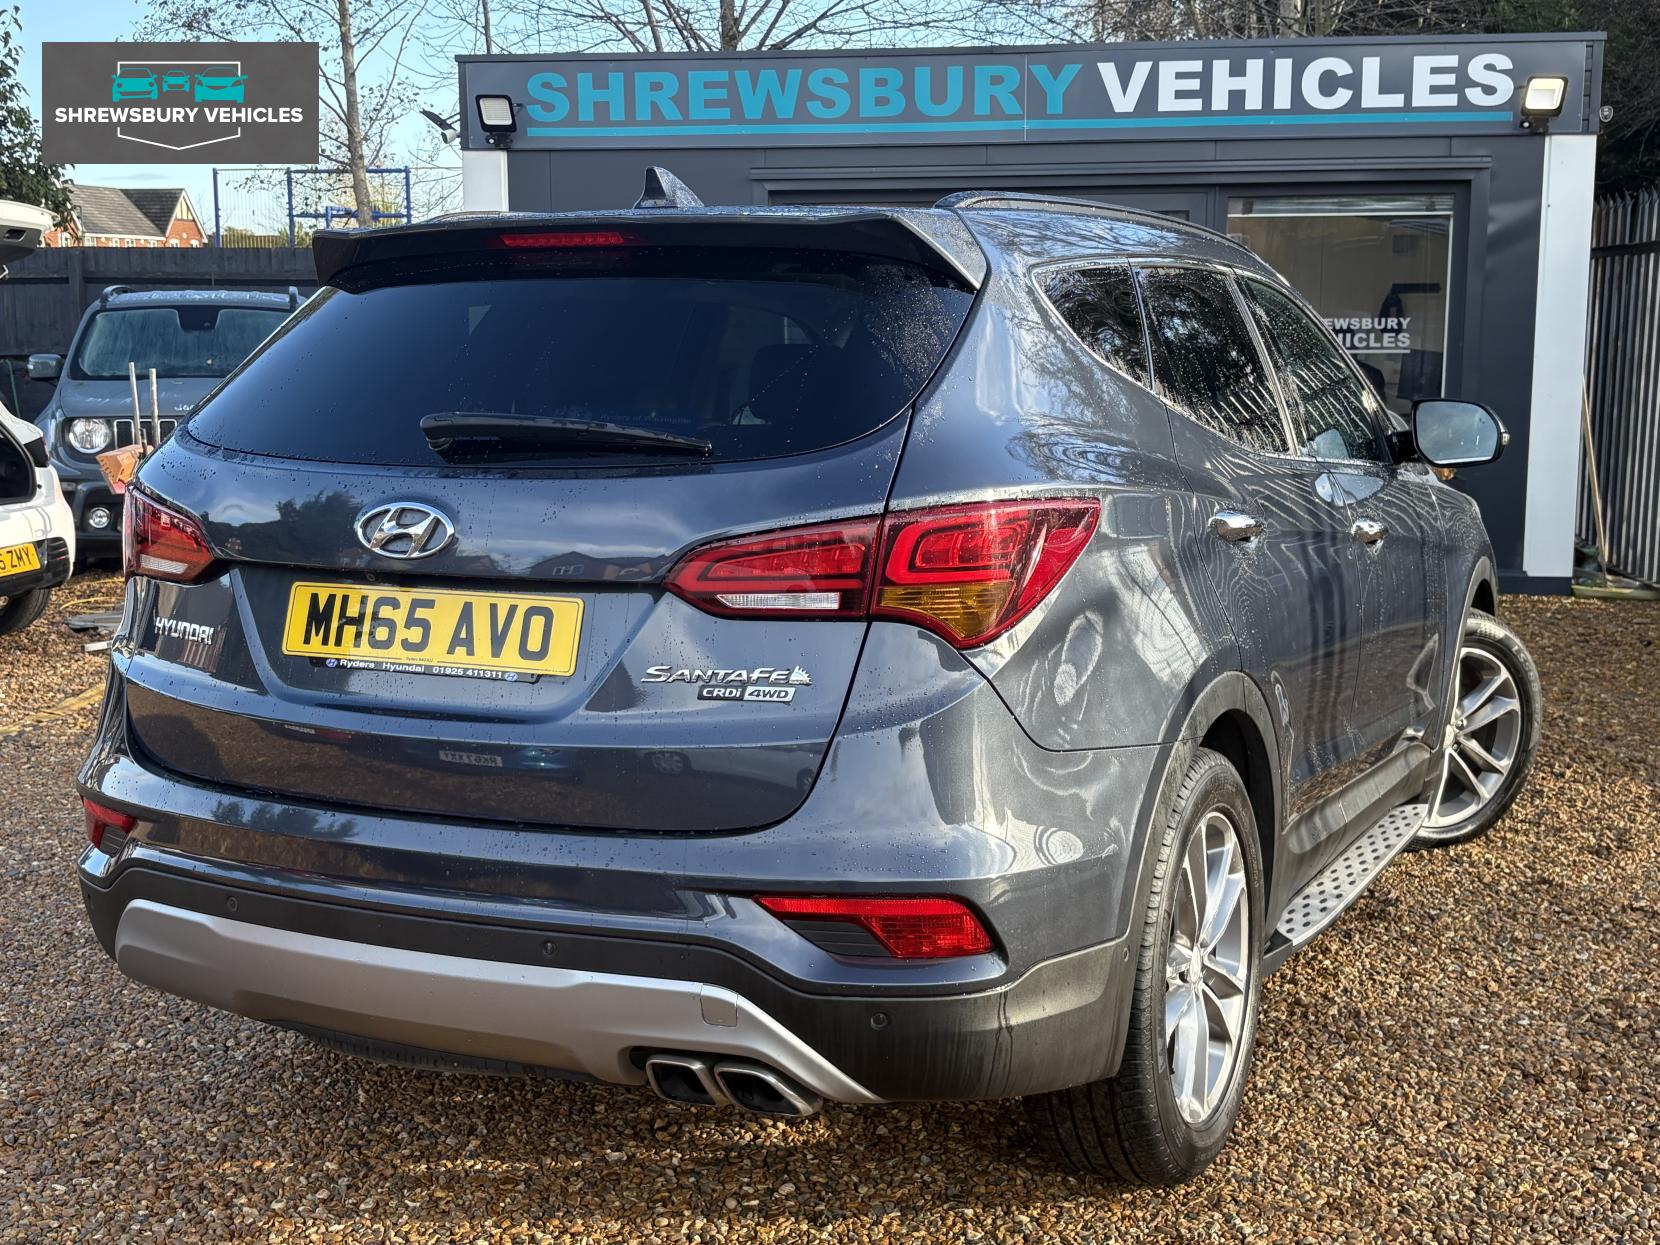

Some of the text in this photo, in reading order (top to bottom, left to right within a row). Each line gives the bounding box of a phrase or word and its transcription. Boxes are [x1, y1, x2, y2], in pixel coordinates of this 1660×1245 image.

[526, 53, 1515, 123] SHREWSBURY VEHICLES
[1324, 317, 1412, 330] EWSBURY
[155, 617, 214, 645] HYUNDAI
[303, 592, 555, 662] MH65 AVO
[340, 659, 503, 679] Ryders Hyundai 01925 411311
[702, 687, 790, 699] CRDi 4WD
